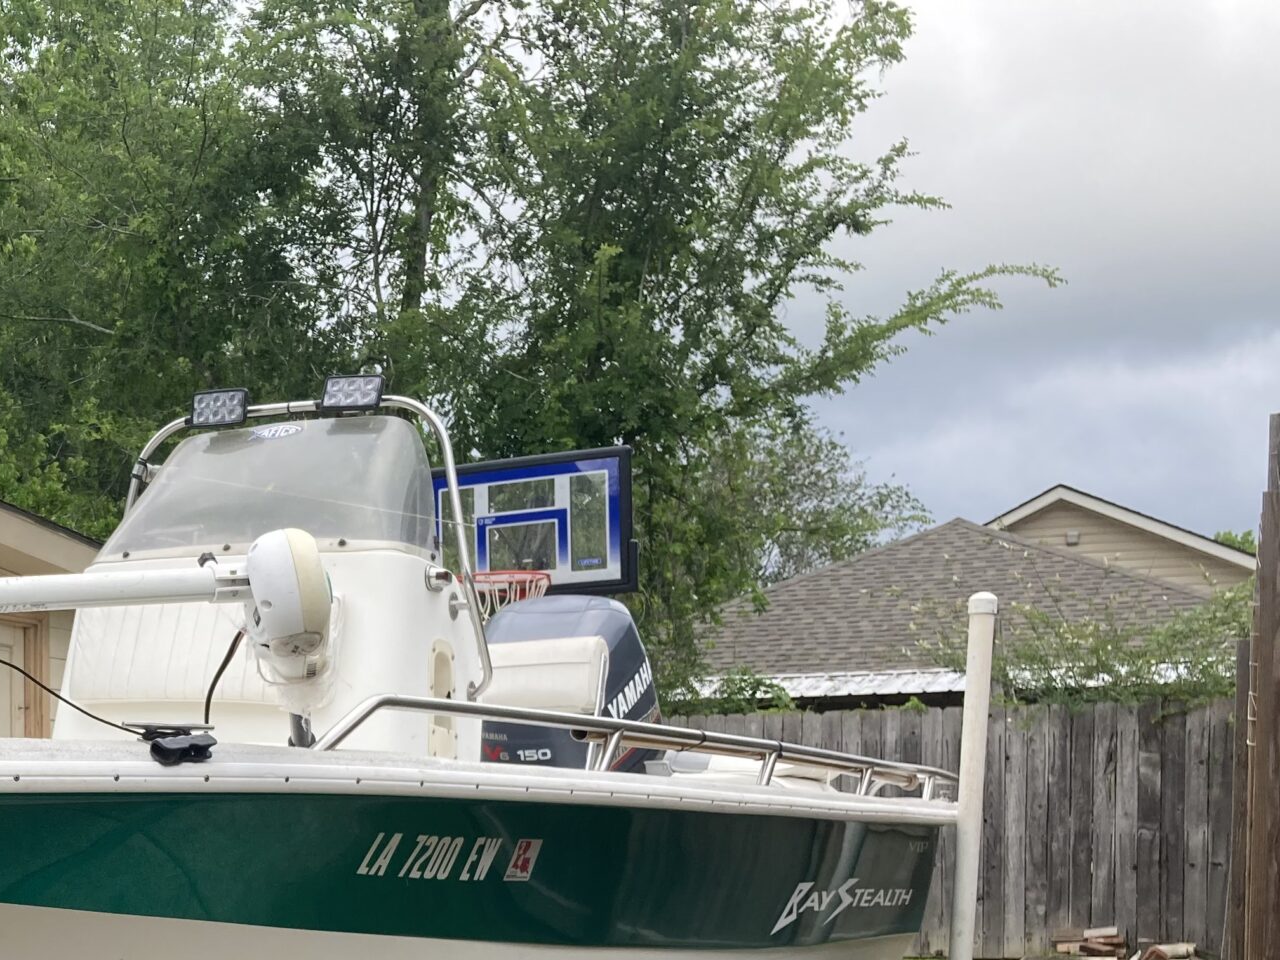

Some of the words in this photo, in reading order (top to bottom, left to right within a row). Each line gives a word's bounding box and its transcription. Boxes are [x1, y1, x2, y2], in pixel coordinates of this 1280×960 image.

[607, 656, 653, 719] YAMAH
[517, 748, 552, 761] 150
[356, 832, 403, 876] LA
[397, 834, 465, 880] 7200
[459, 837, 503, 881] EW
